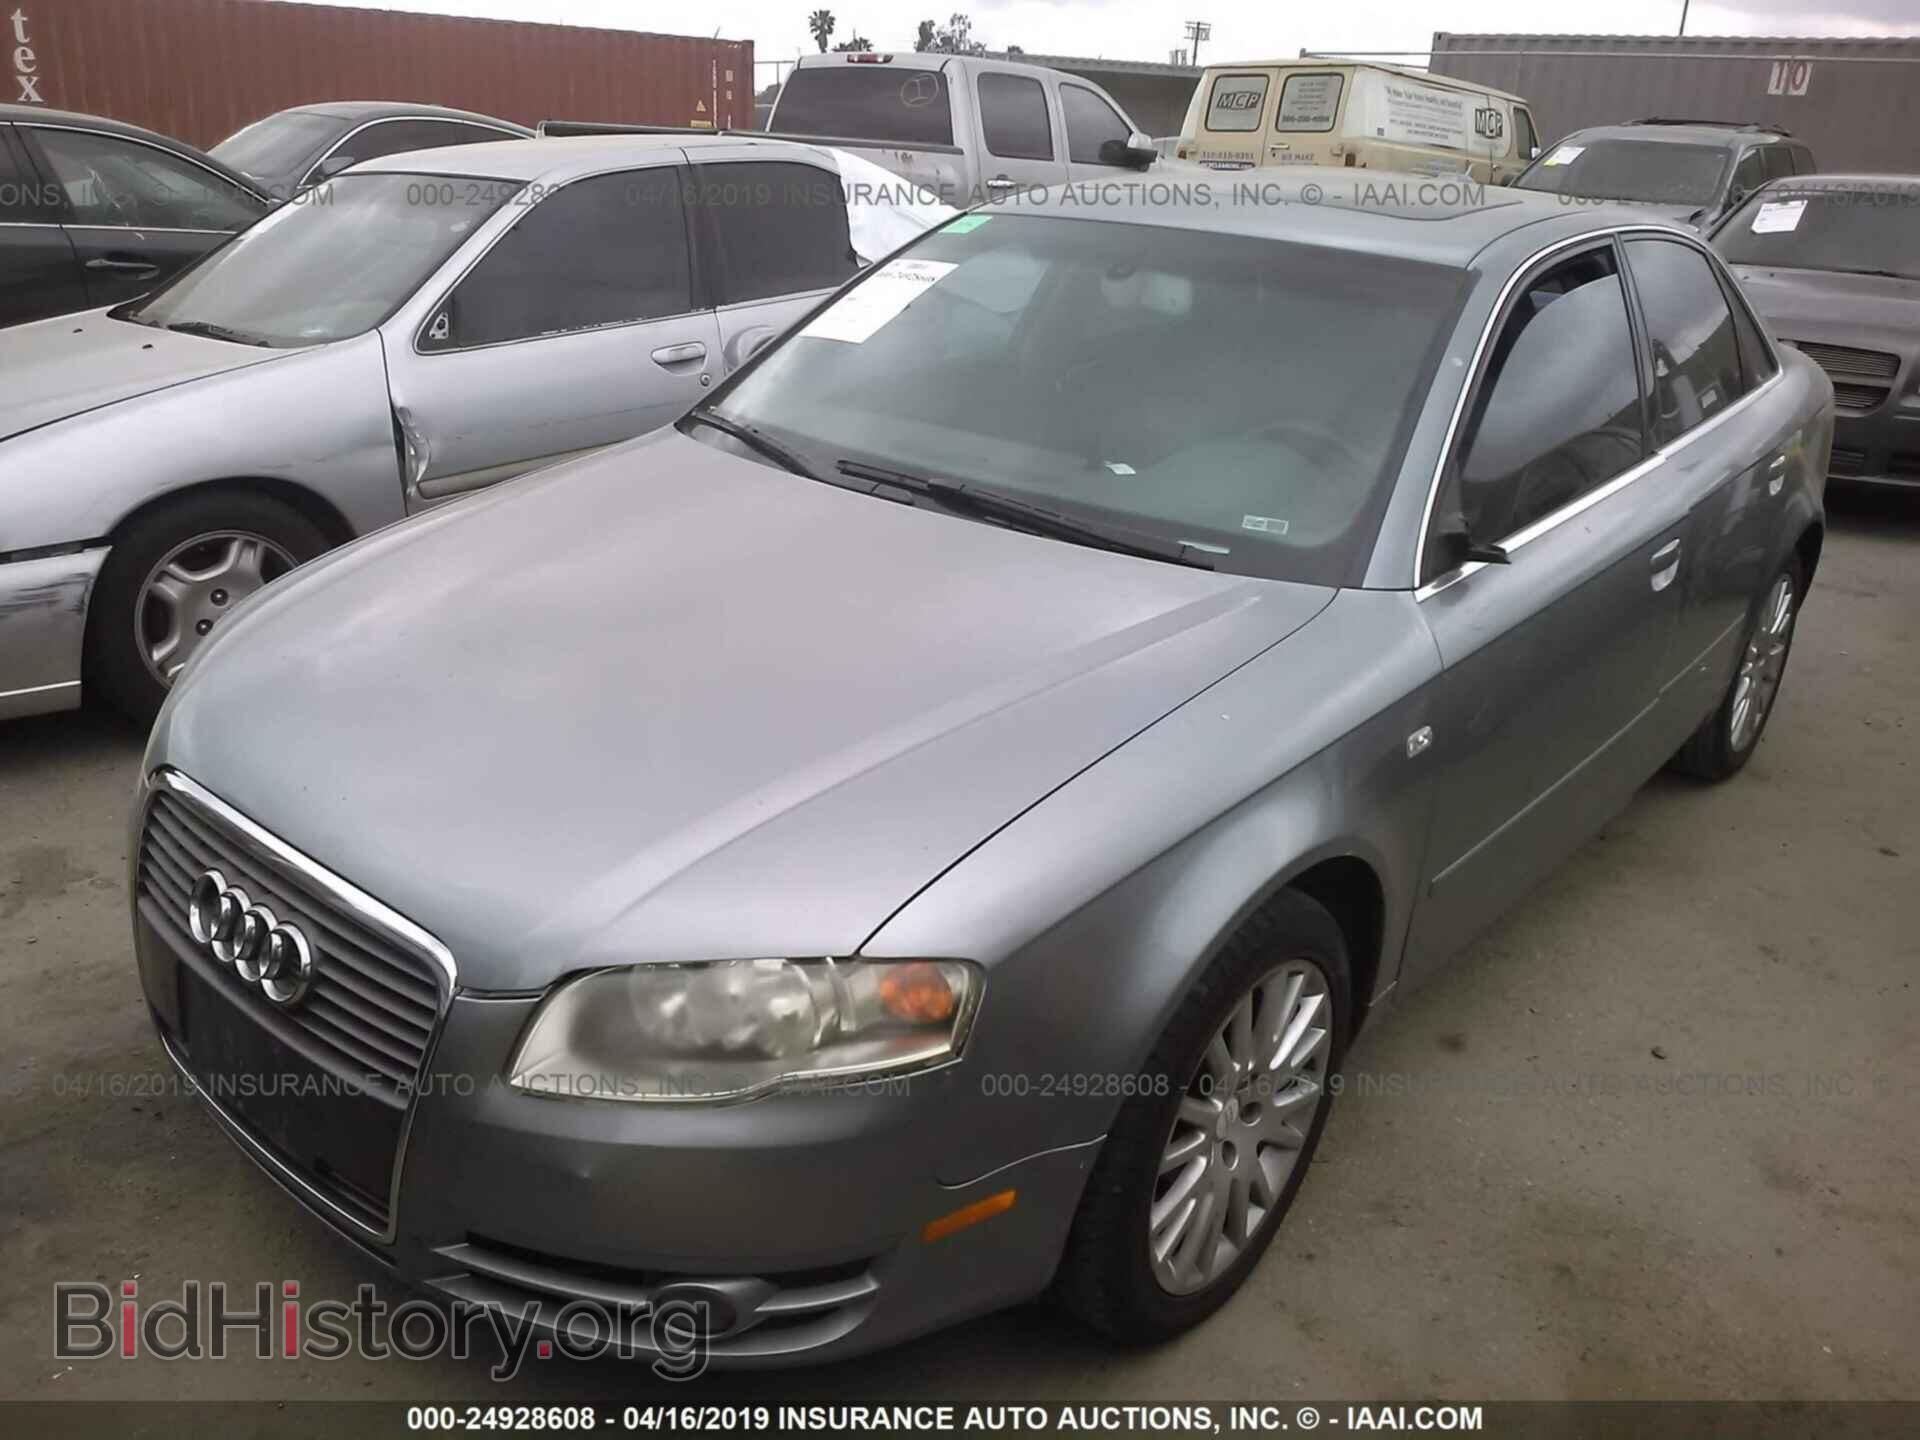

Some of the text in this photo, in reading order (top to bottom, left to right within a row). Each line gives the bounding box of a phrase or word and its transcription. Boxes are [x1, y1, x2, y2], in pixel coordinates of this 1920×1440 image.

[10, 8, 44, 102] tex
[1217, 91, 1261, 110] MCP
[1475, 108, 1503, 138] MCP
